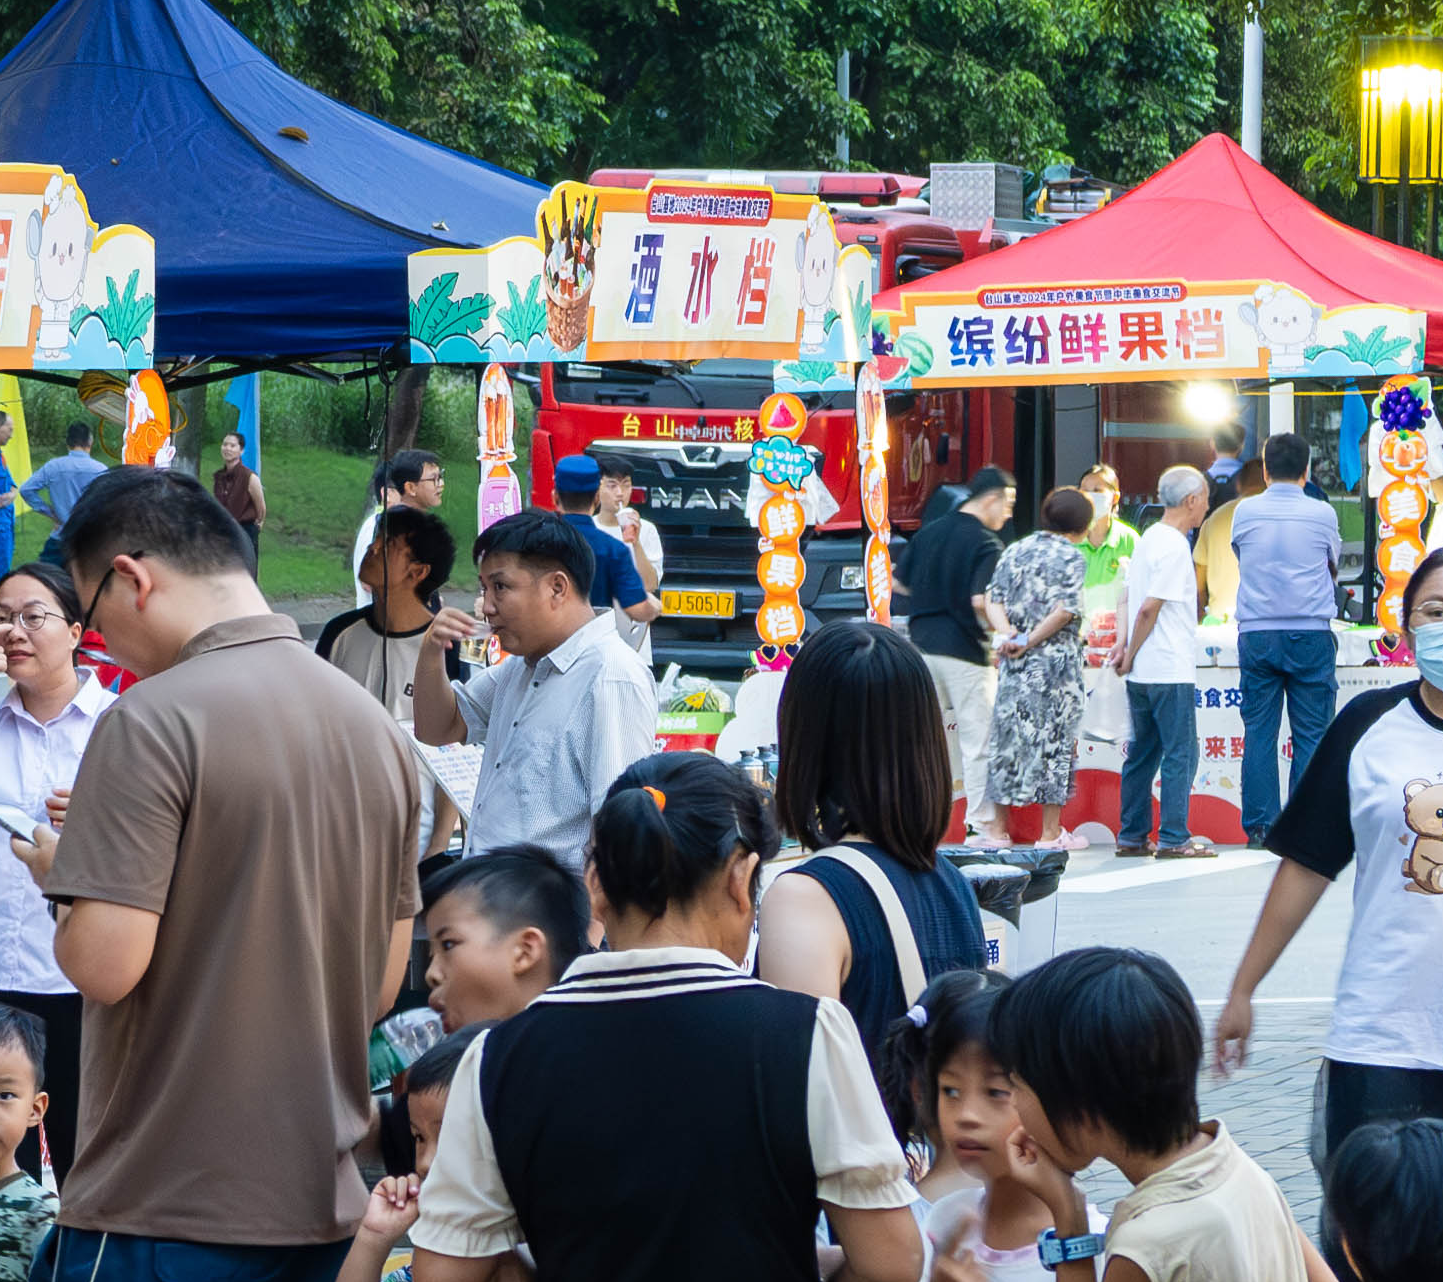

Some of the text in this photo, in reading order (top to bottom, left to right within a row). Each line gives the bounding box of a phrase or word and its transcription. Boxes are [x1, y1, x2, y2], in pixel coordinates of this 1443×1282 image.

[625, 231, 778, 327] 酒水档
[946, 308, 1226, 368] 缤纷鲜果档
[871, 549, 890, 608] 美
